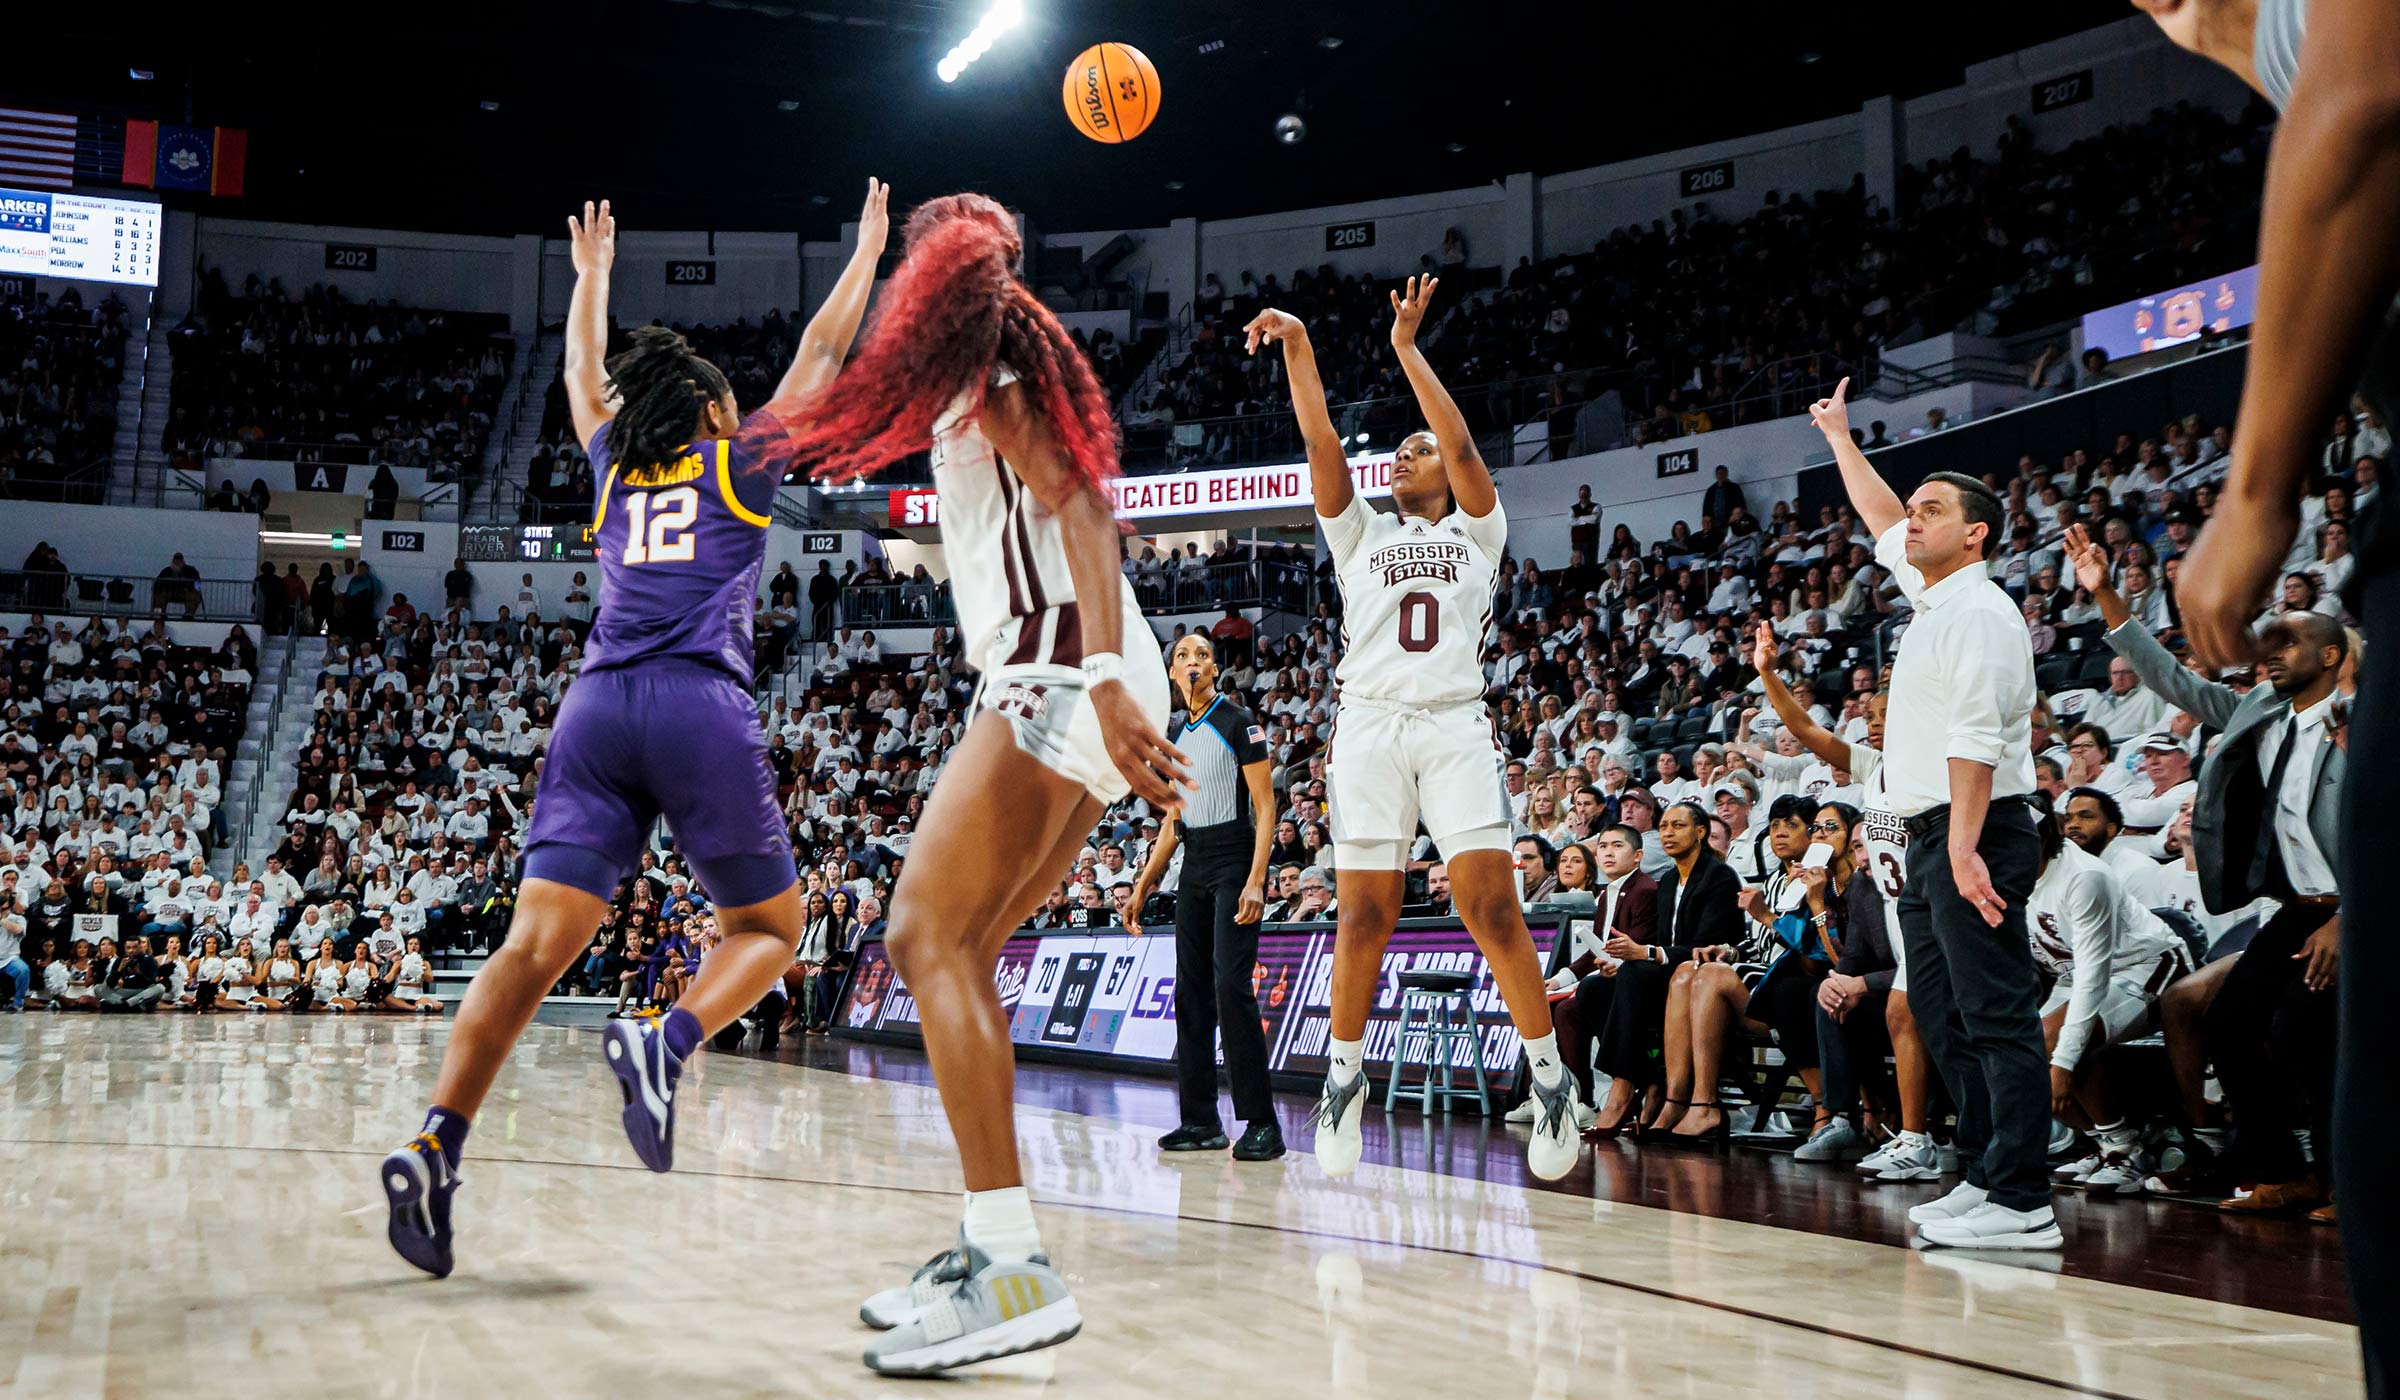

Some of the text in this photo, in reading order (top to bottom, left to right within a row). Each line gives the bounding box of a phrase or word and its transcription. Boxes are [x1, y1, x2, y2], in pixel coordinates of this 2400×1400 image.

[1086, 66, 1109, 129] Wilson
[2043, 80, 2080, 106] 207
[1690, 169, 1725, 191] 206
[53, 211, 89, 221] JOHNSON
[115, 216, 124, 225] 18
[132, 218, 139, 226] 4
[53, 223, 76, 232] REESE
[146, 231, 152, 240] 3
[1334, 227, 1366, 246] 205
[52, 235, 89, 245] WILLIAMS
[131, 242, 137, 251] 3
[146, 243, 152, 252] 2
[51, 246, 66, 255] POA
[114, 252, 120, 261] 2
[145, 255, 151, 264] 3
[335, 250, 368, 266] 202
[50, 259, 84, 269] MORROW
[112, 265, 121, 273] 14
[129, 266, 136, 274] 5
[675, 265, 706, 280] 203
[1665, 453, 1690, 473] 104
[311, 467, 329, 488] A
[1209, 472, 1298, 503] BEHIND
[524, 526, 553, 538] STATE
[624, 487, 699, 566] 12
[391, 534, 416, 548] 102
[464, 543, 504, 552] RIVER
[467, 535, 503, 543] PEARL
[811, 537, 834, 550] 102
[461, 551, 509, 560] RESORT
[521, 540, 541, 558] 70
[1370, 545, 1470, 570] MISSISSIPPI
[1394, 562, 1446, 581] STATE
[1398, 592, 1439, 652] 0
[1872, 829, 1902, 844] STATE
[1879, 852, 1905, 897] 3
[1071, 908, 1088, 922] POSS
[1034, 957, 1061, 994] 70
[1105, 956, 1136, 995] 67
[1063, 984, 1085, 1007] 1:11
[1130, 975, 1177, 1020] LS
[1291, 1017, 1332, 1055] JOIN
